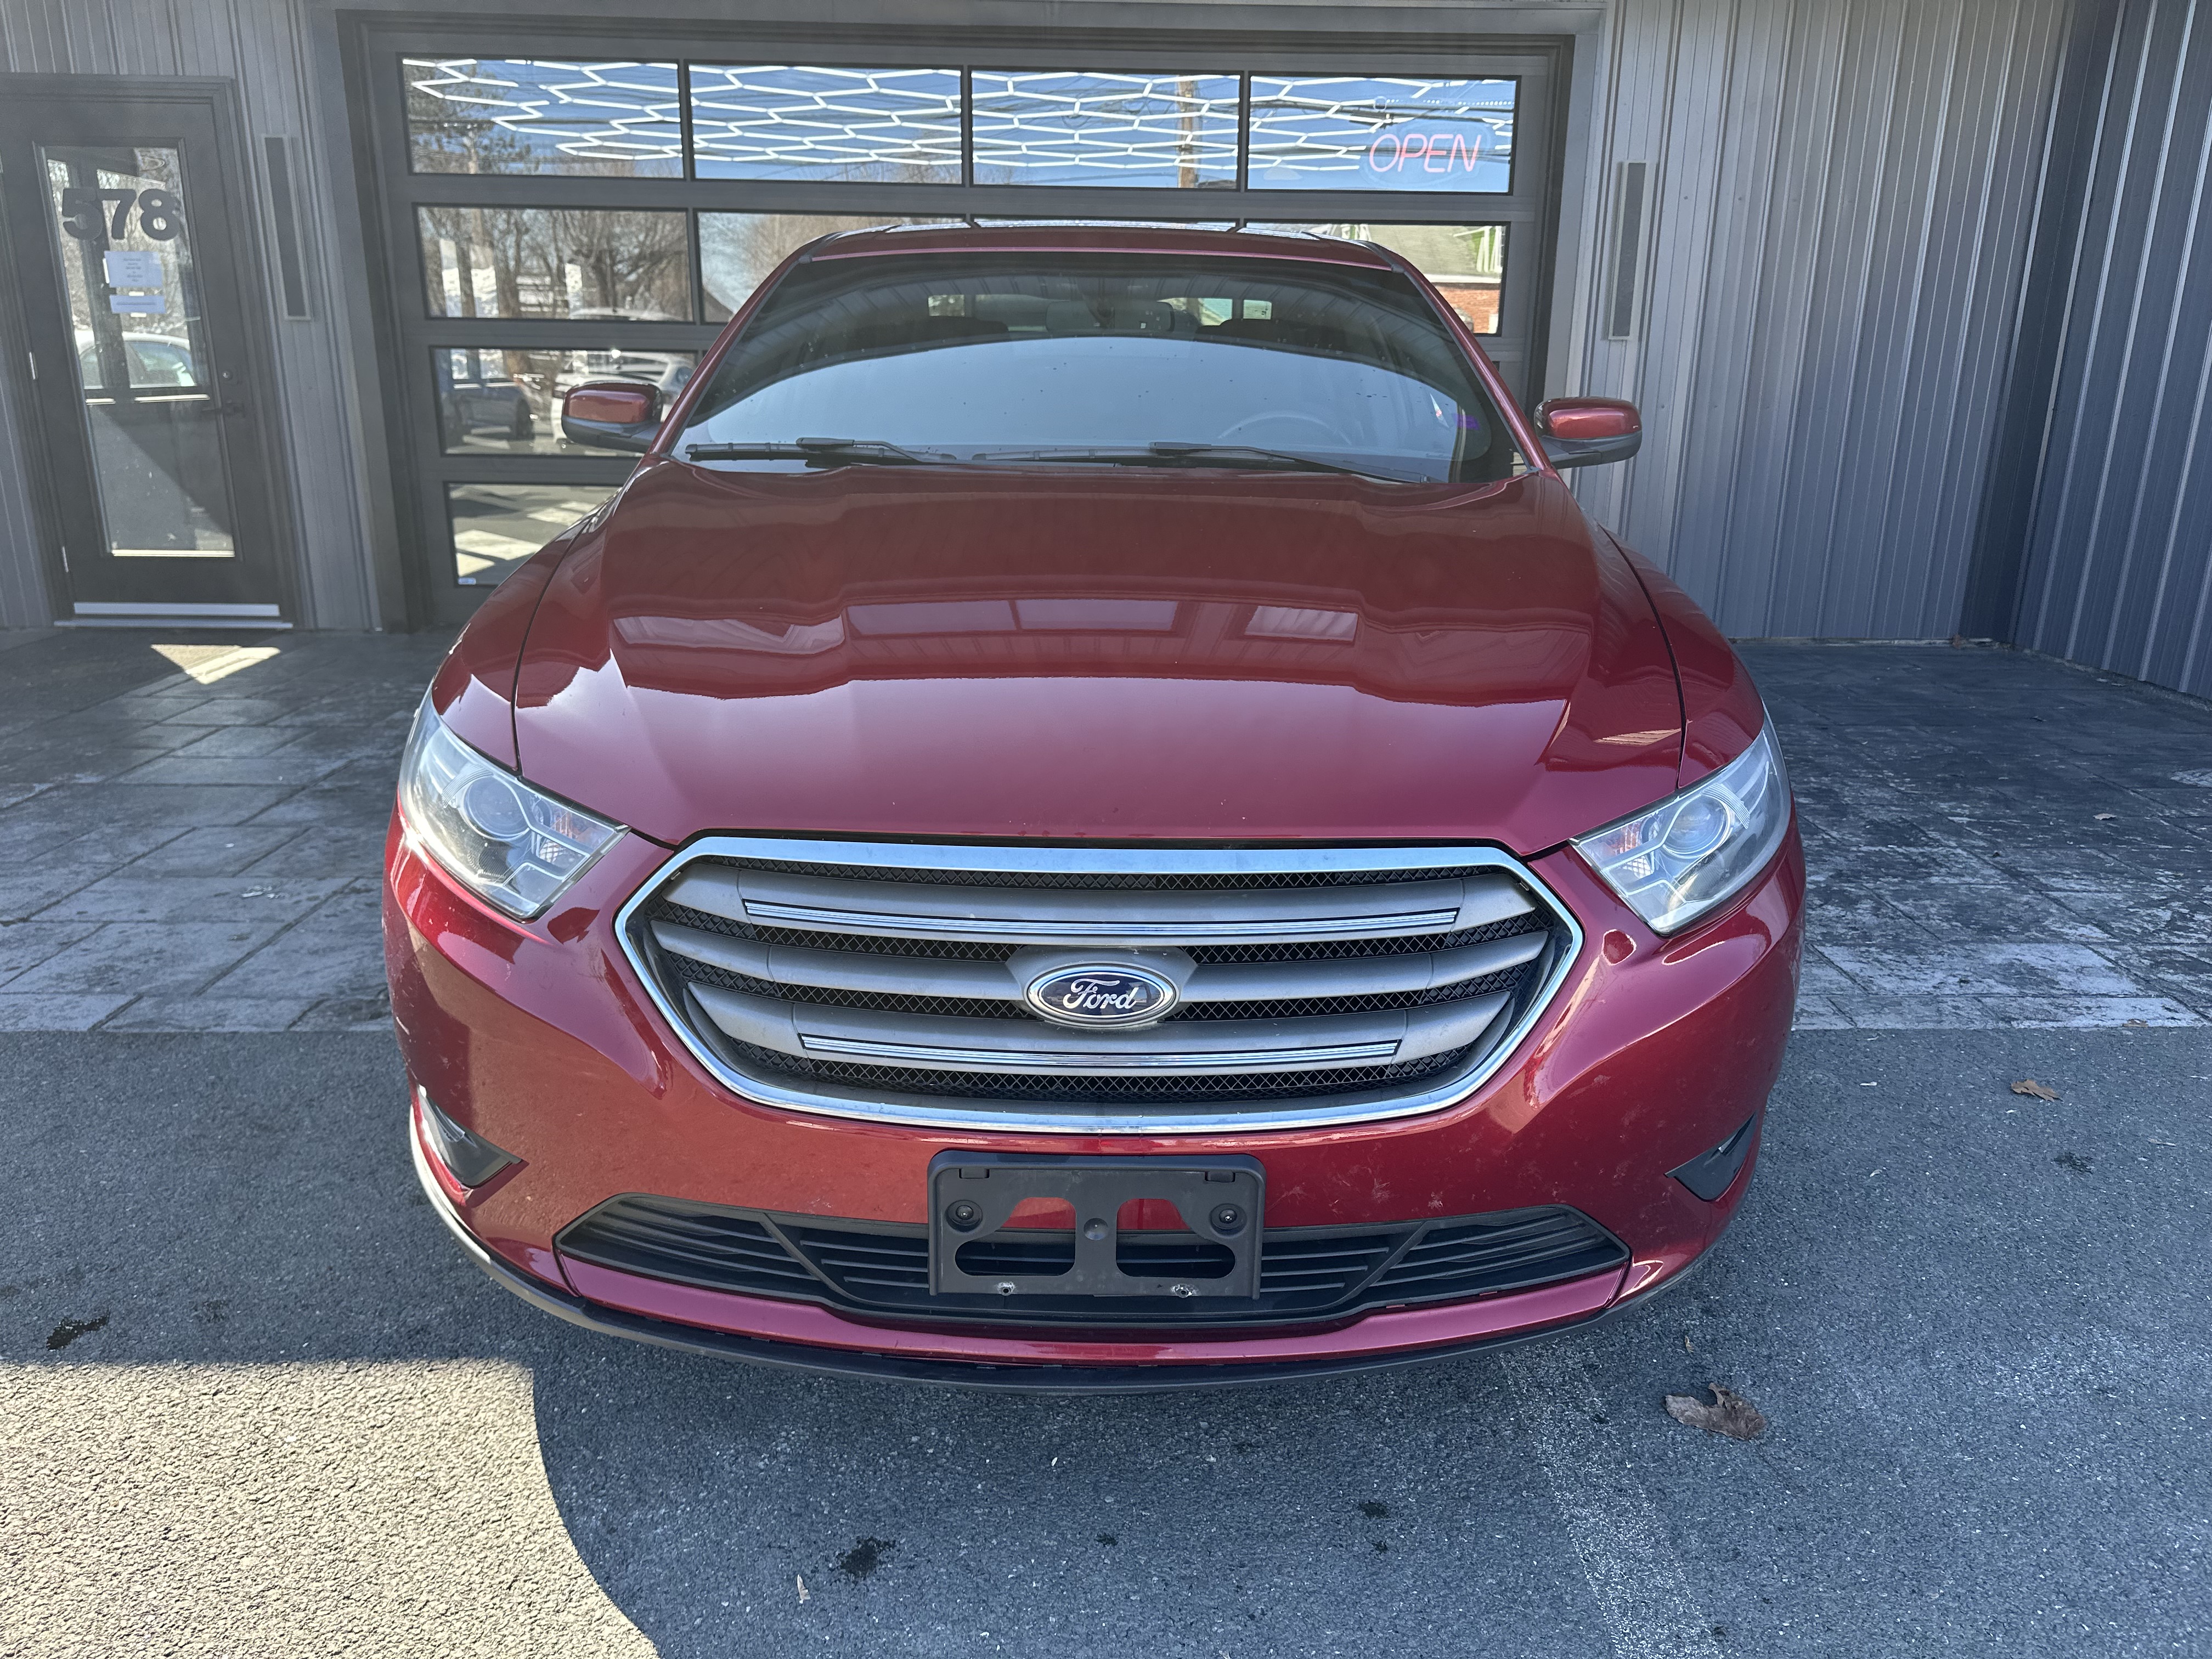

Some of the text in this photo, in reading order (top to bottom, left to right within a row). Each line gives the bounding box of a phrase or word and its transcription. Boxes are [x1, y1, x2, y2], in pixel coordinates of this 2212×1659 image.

[1369, 133, 1481, 172] OPEN
[61, 188, 180, 241] 578
[1063, 978, 1139, 1009] Ford
